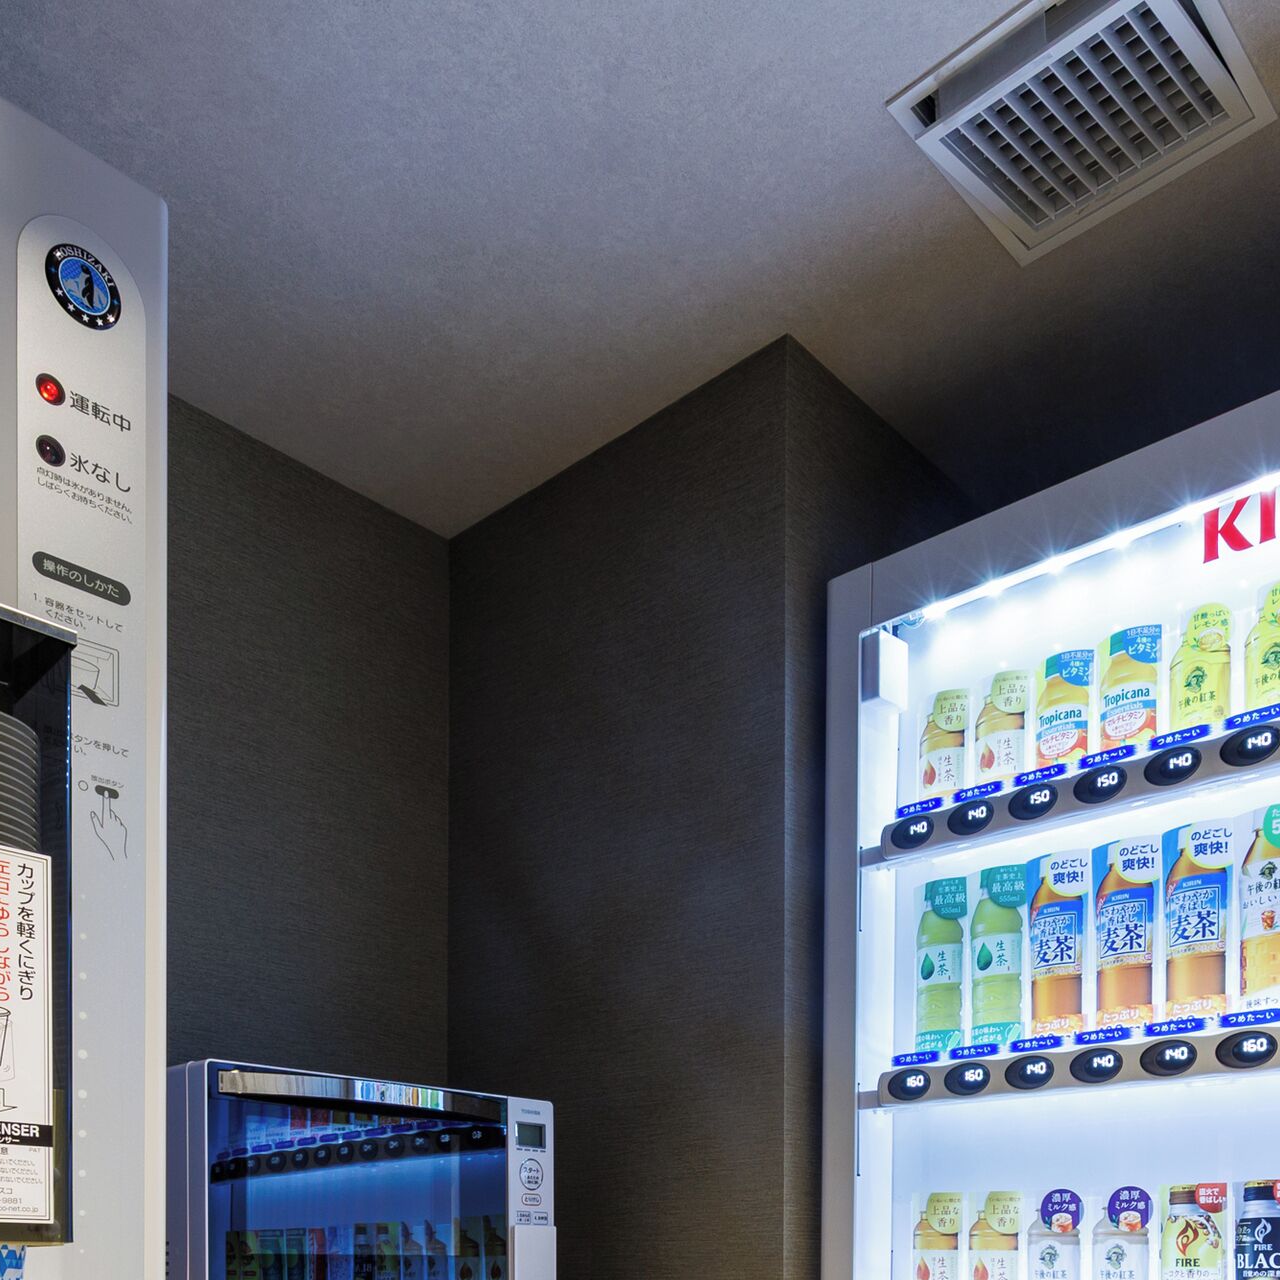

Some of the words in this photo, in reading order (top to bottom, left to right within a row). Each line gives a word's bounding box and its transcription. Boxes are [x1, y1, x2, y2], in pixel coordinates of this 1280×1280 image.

[53, 246, 114, 287] HOSHIZAKI
[70, 390, 131, 432] 運転中
[70, 452, 131, 492] 氷なし
[37, 467, 132, 513] 点灯時は氷がありません。
[37, 477, 133, 524] しばらくお待ちください。
[43, 559, 120, 598] 操作のしかた
[45, 596, 123, 632] 容器をセットして
[1104, 686, 1150, 707] Tropicana
[1040, 707, 1081, 727] Tropicana
[1247, 733, 1271, 748] 140
[1098, 773, 1118, 787] 150
[1030, 789, 1049, 803] 150
[910, 821, 927, 835] 140
[1191, 828, 1232, 841] のどごし
[1120, 844, 1159, 857] のどごし
[1051, 859, 1088, 871] のどごし
[17, 864, 35, 1000] カップを軽くにぎり
[1171, 910, 1216, 940] 麦茶
[1102, 923, 1144, 952] 麦茶
[1035, 937, 1073, 966] 麦茶
[1243, 1038, 1267, 1052] 160
[1027, 1062, 1046, 1075] 140
[1093, 1054, 1114, 1067] 140
[907, 1075, 923, 1087] 160
[1176, 1258, 1200, 1267] FIRE
